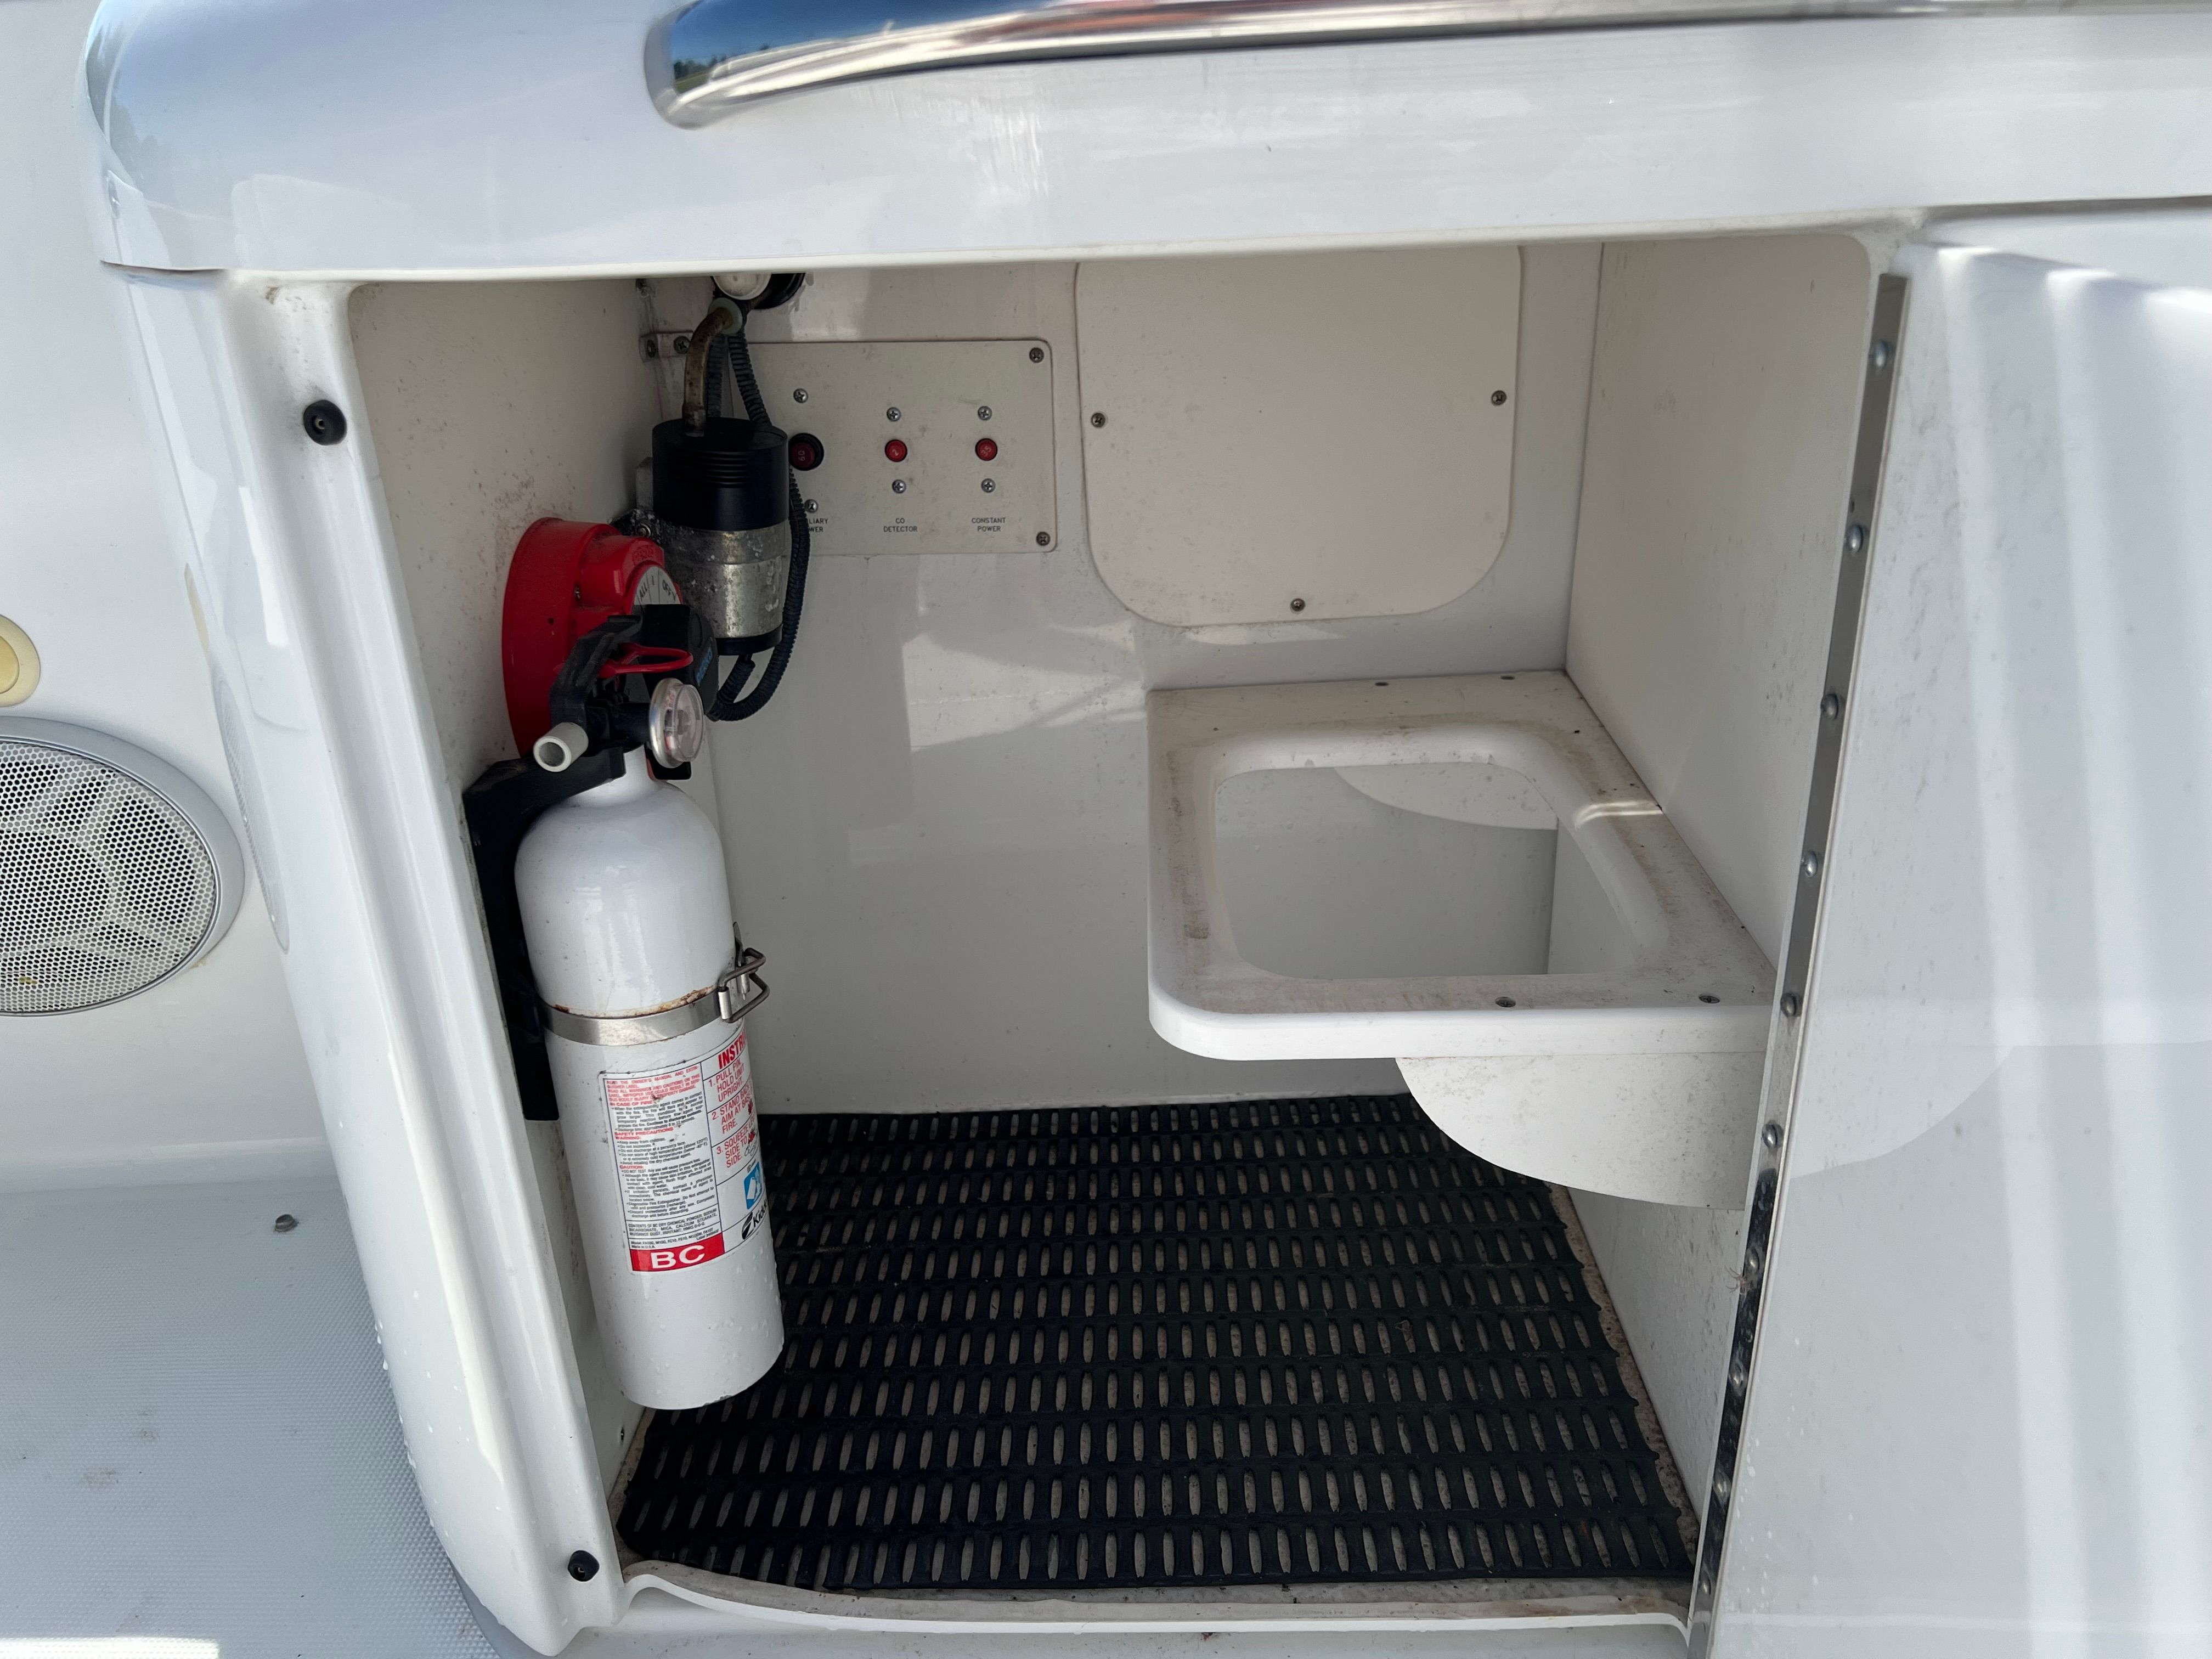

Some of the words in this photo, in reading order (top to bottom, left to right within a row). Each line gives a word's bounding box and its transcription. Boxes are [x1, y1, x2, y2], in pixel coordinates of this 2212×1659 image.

[716, 1068, 732, 1084] PULL
[716, 1075, 734, 1093] HOLD
[735, 1063, 744, 1080] UNIT
[718, 1076, 744, 1102] UPRIGHT.
[720, 1095, 740, 1115] STAND
[721, 1110, 734, 1125] AIM
[735, 1105, 741, 1118] AT
[724, 1126, 748, 1150] SQUEEZE
[725, 1143, 740, 1159] SIDE
[741, 1136, 747, 1146] TO
[651, 1245, 704, 1269] BC
